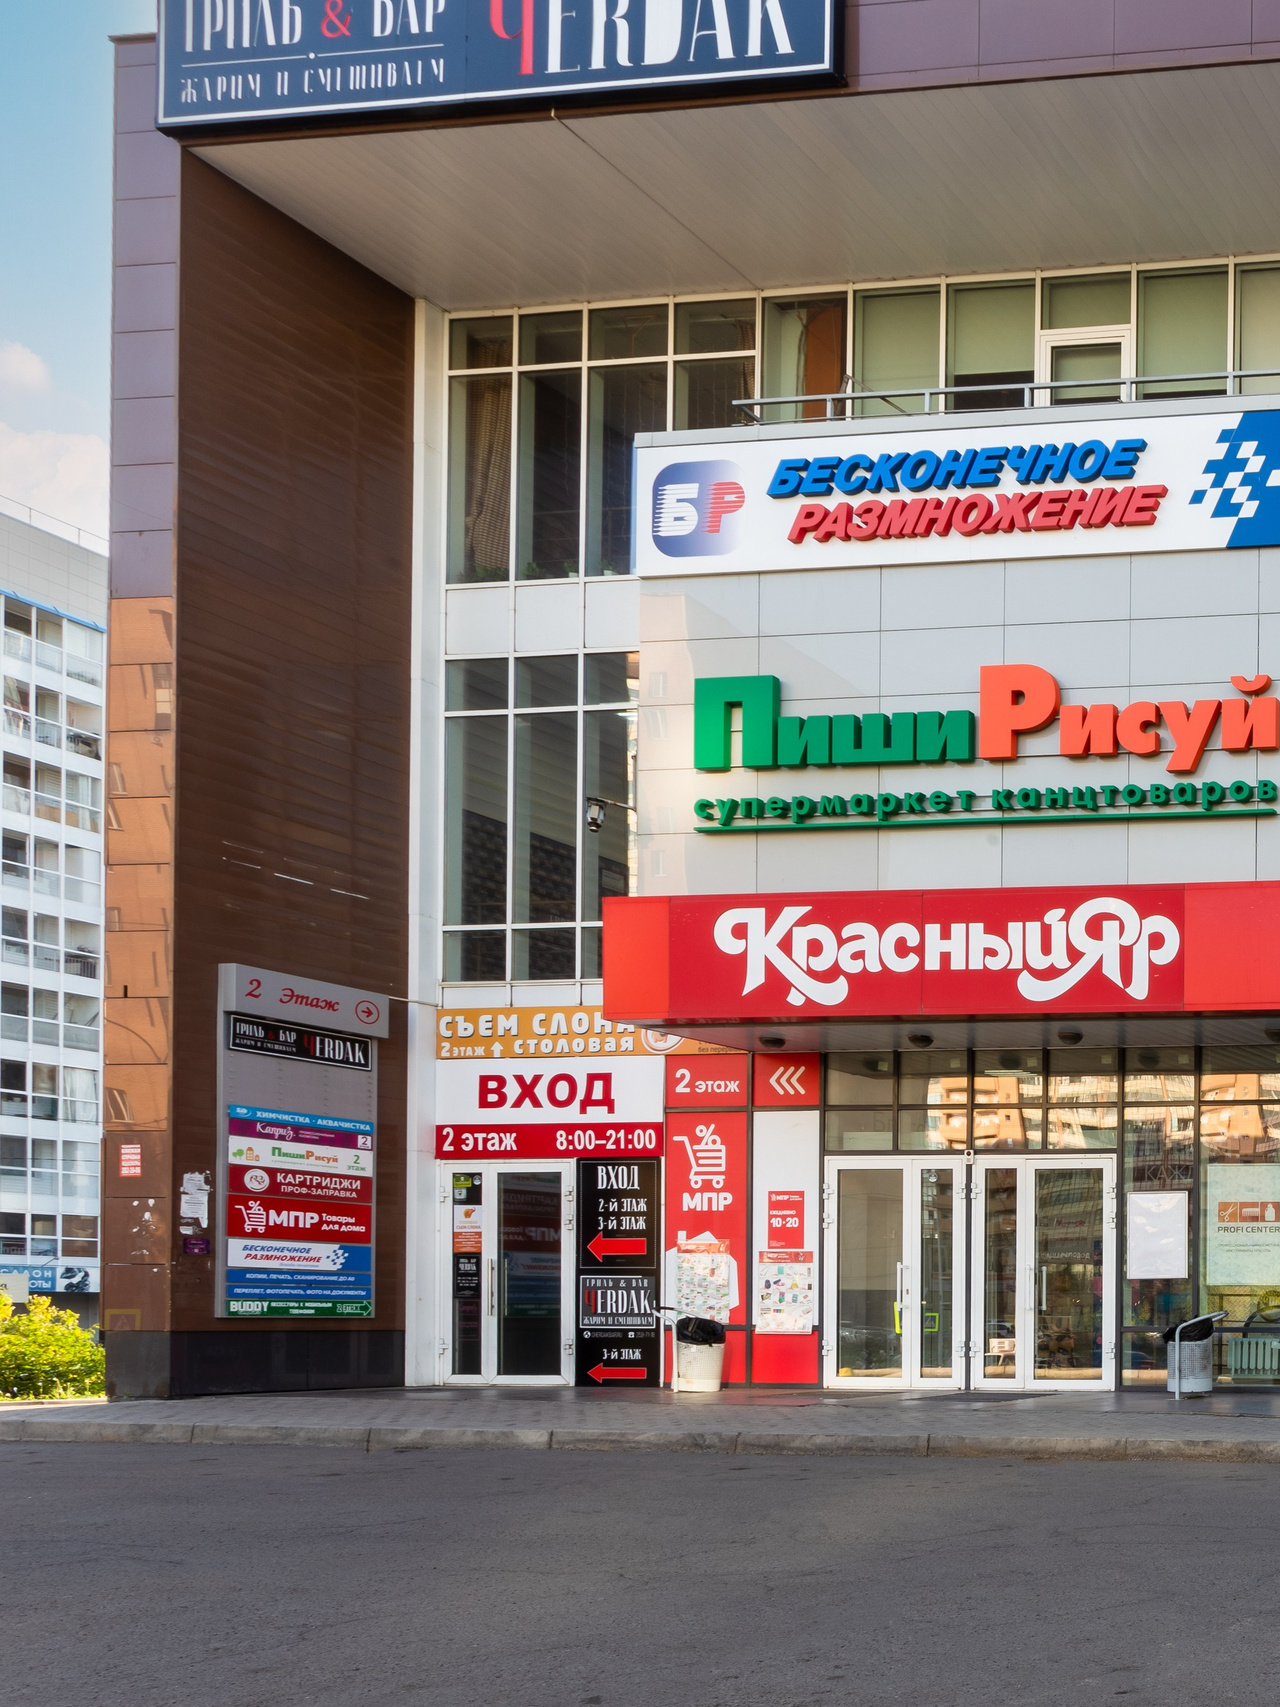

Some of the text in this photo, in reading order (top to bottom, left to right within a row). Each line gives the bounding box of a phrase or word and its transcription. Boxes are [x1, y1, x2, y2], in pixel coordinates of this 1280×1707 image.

[767, 438, 1148, 499] БЕСКОНЕЧНОЕ
[786, 484, 1169, 545] РАЗМНОЖЕНИЕ
[694, 778, 1278, 827] супермаркет канцтоваров
[245, 978, 340, 1012] 2 Этаж
[439, 1014, 518, 1038] СЪЕМ
[440, 1042, 450, 1057] 2
[674, 1068, 740, 1094] 2 этаж
[478, 1072, 616, 1115] ВХОД
[255, 1110, 371, 1131] ХИМЧИСТКА АКВАЧИСТКА
[442, 1127, 454, 1152] 2
[461, 1132, 518, 1152] этаж
[353, 1154, 361, 1165] 2
[276, 1173, 361, 1189] КАРТРИДЖИ
[597, 1165, 640, 1191] ВХОД
[281, 1185, 358, 1198] ПРОФ-ЗАПРАВКА
[620, 1198, 647, 1212] ЭТАЖ
[682, 1192, 733, 1211] МПР
[268, 1209, 320, 1228] МПР
[322, 1213, 356, 1223] Товары
[619, 1216, 647, 1230] ЭТАЖ
[1217, 1226, 1280, 1234] PROFI CENTER
[242, 1244, 312, 1255] БЕСКОНЕЧНОЕ
[244, 1253, 323, 1263] РАЗМНОЖЕНИЕ
[619, 1279, 627, 1287] &
[230, 1301, 269, 1312] BUDDY
[620, 1348, 642, 1360] ЭТАЖ
